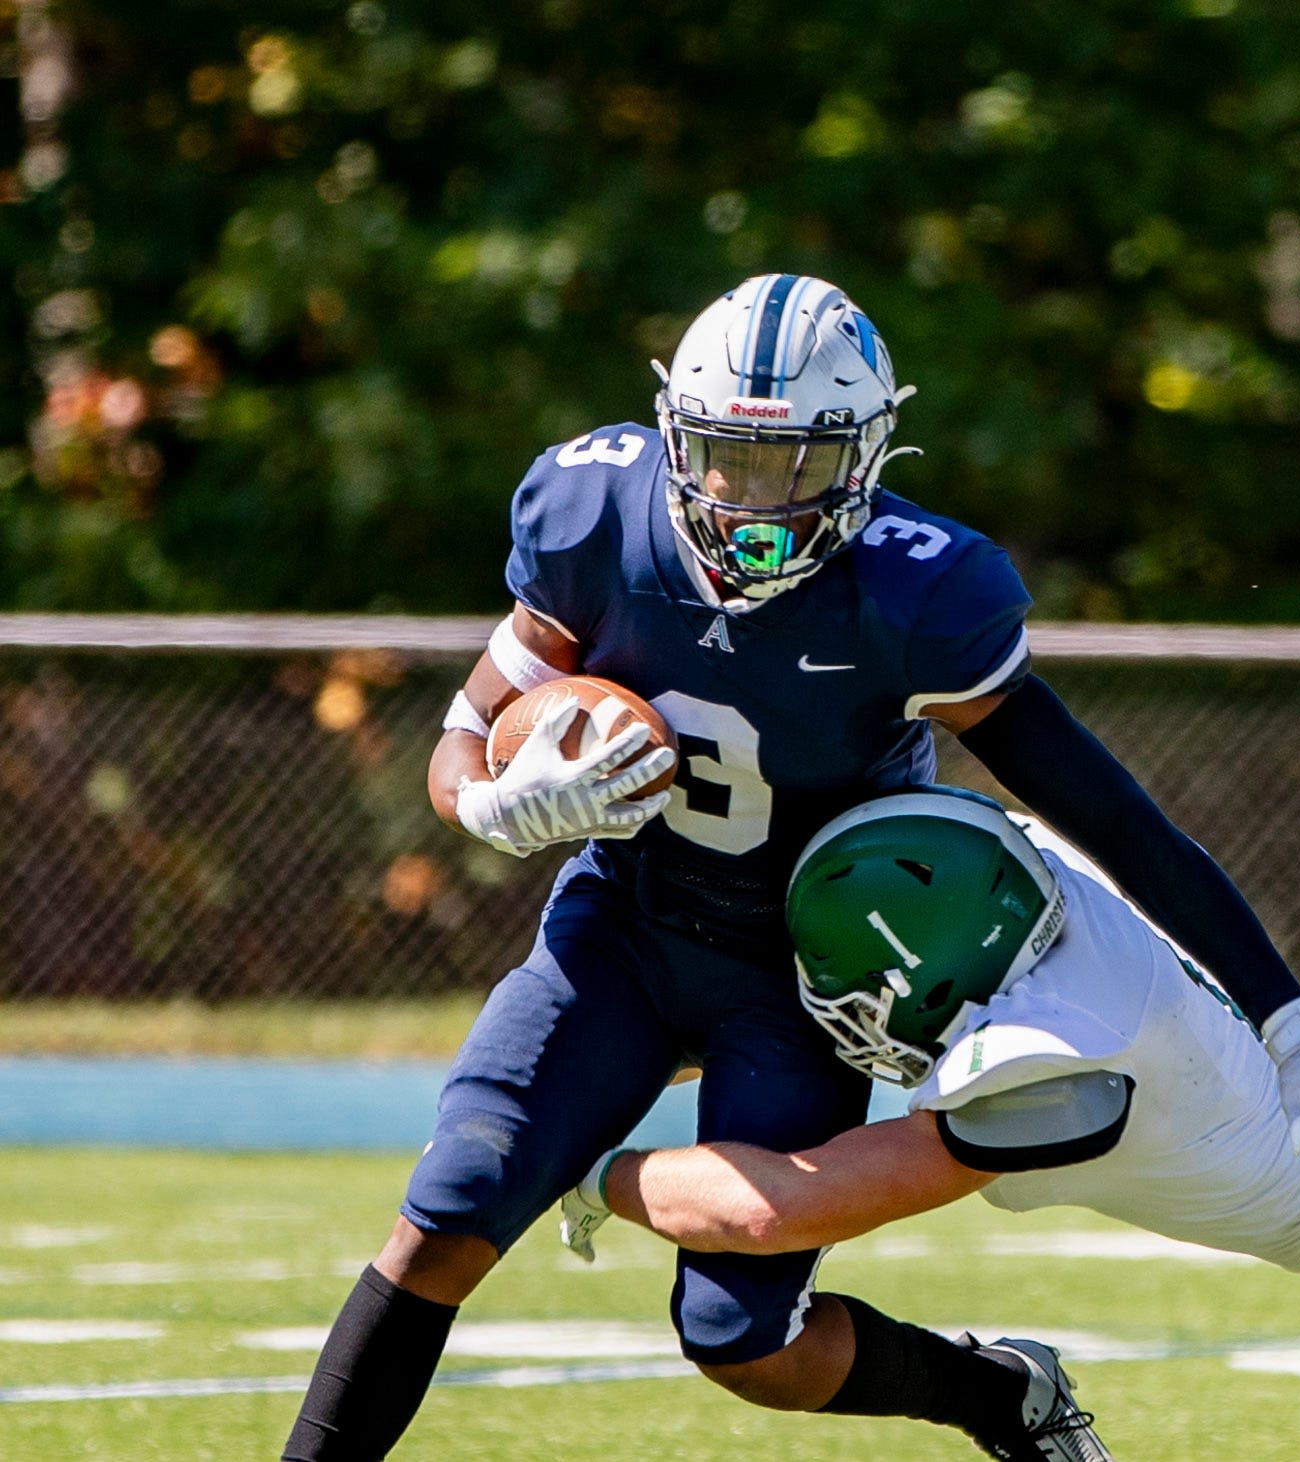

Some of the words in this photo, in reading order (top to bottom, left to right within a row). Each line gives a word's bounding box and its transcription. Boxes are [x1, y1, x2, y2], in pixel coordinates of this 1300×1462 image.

[730, 403, 790, 419] Riddell
[556, 433, 646, 469] 3
[862, 515, 951, 560] 3
[698, 615, 734, 653] A
[648, 690, 772, 855] 3
[866, 910, 923, 969] 1
